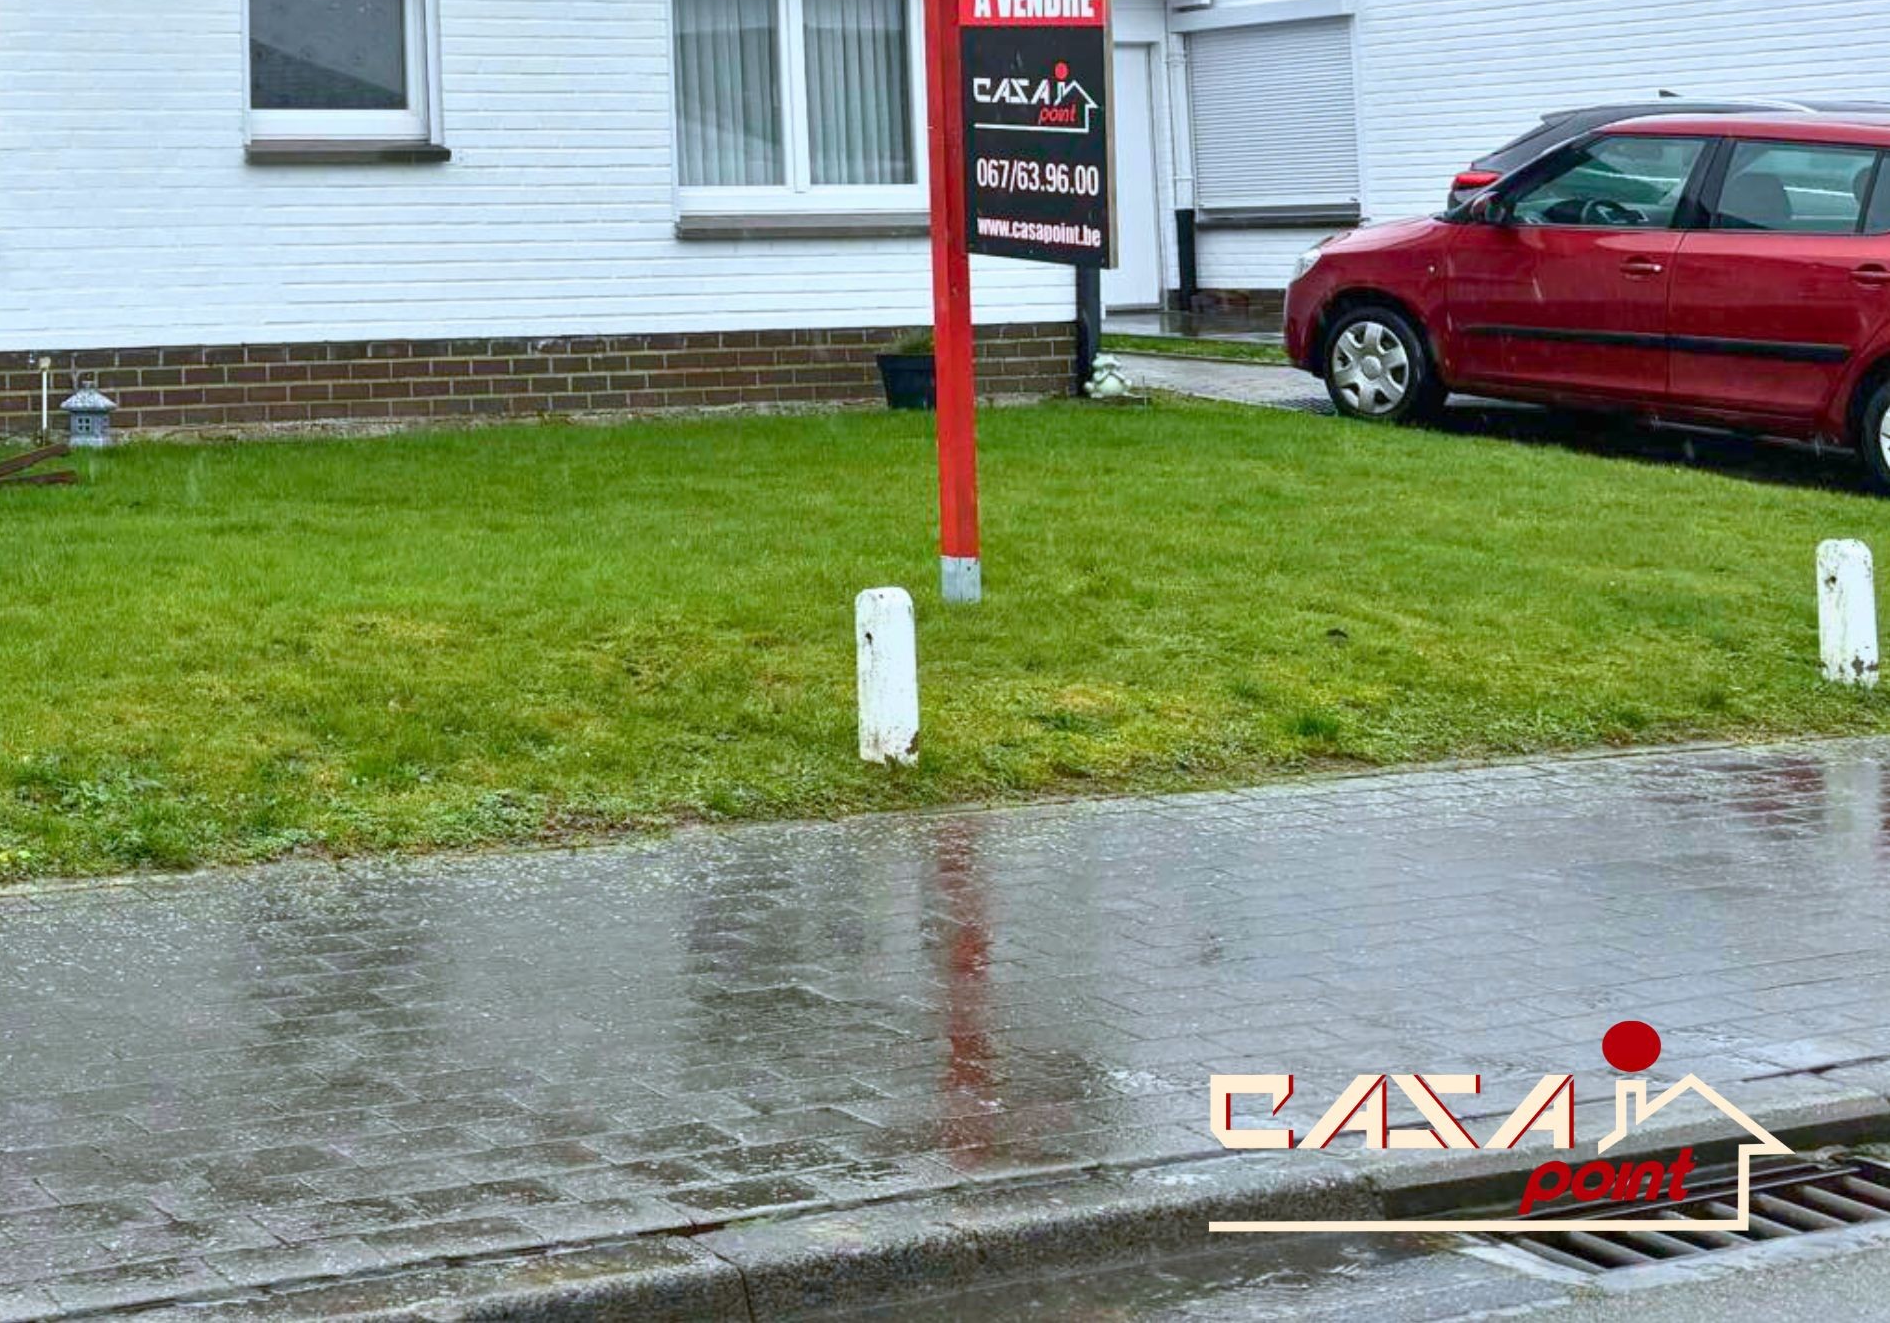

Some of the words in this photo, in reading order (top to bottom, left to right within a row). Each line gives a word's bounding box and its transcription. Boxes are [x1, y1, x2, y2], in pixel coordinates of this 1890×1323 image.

[973, 77, 1050, 105] CASA
[1038, 105, 1077, 125] point
[976, 158, 1099, 196] 067/63.96.00
[976, 217, 1101, 247] www.casapoint.be
